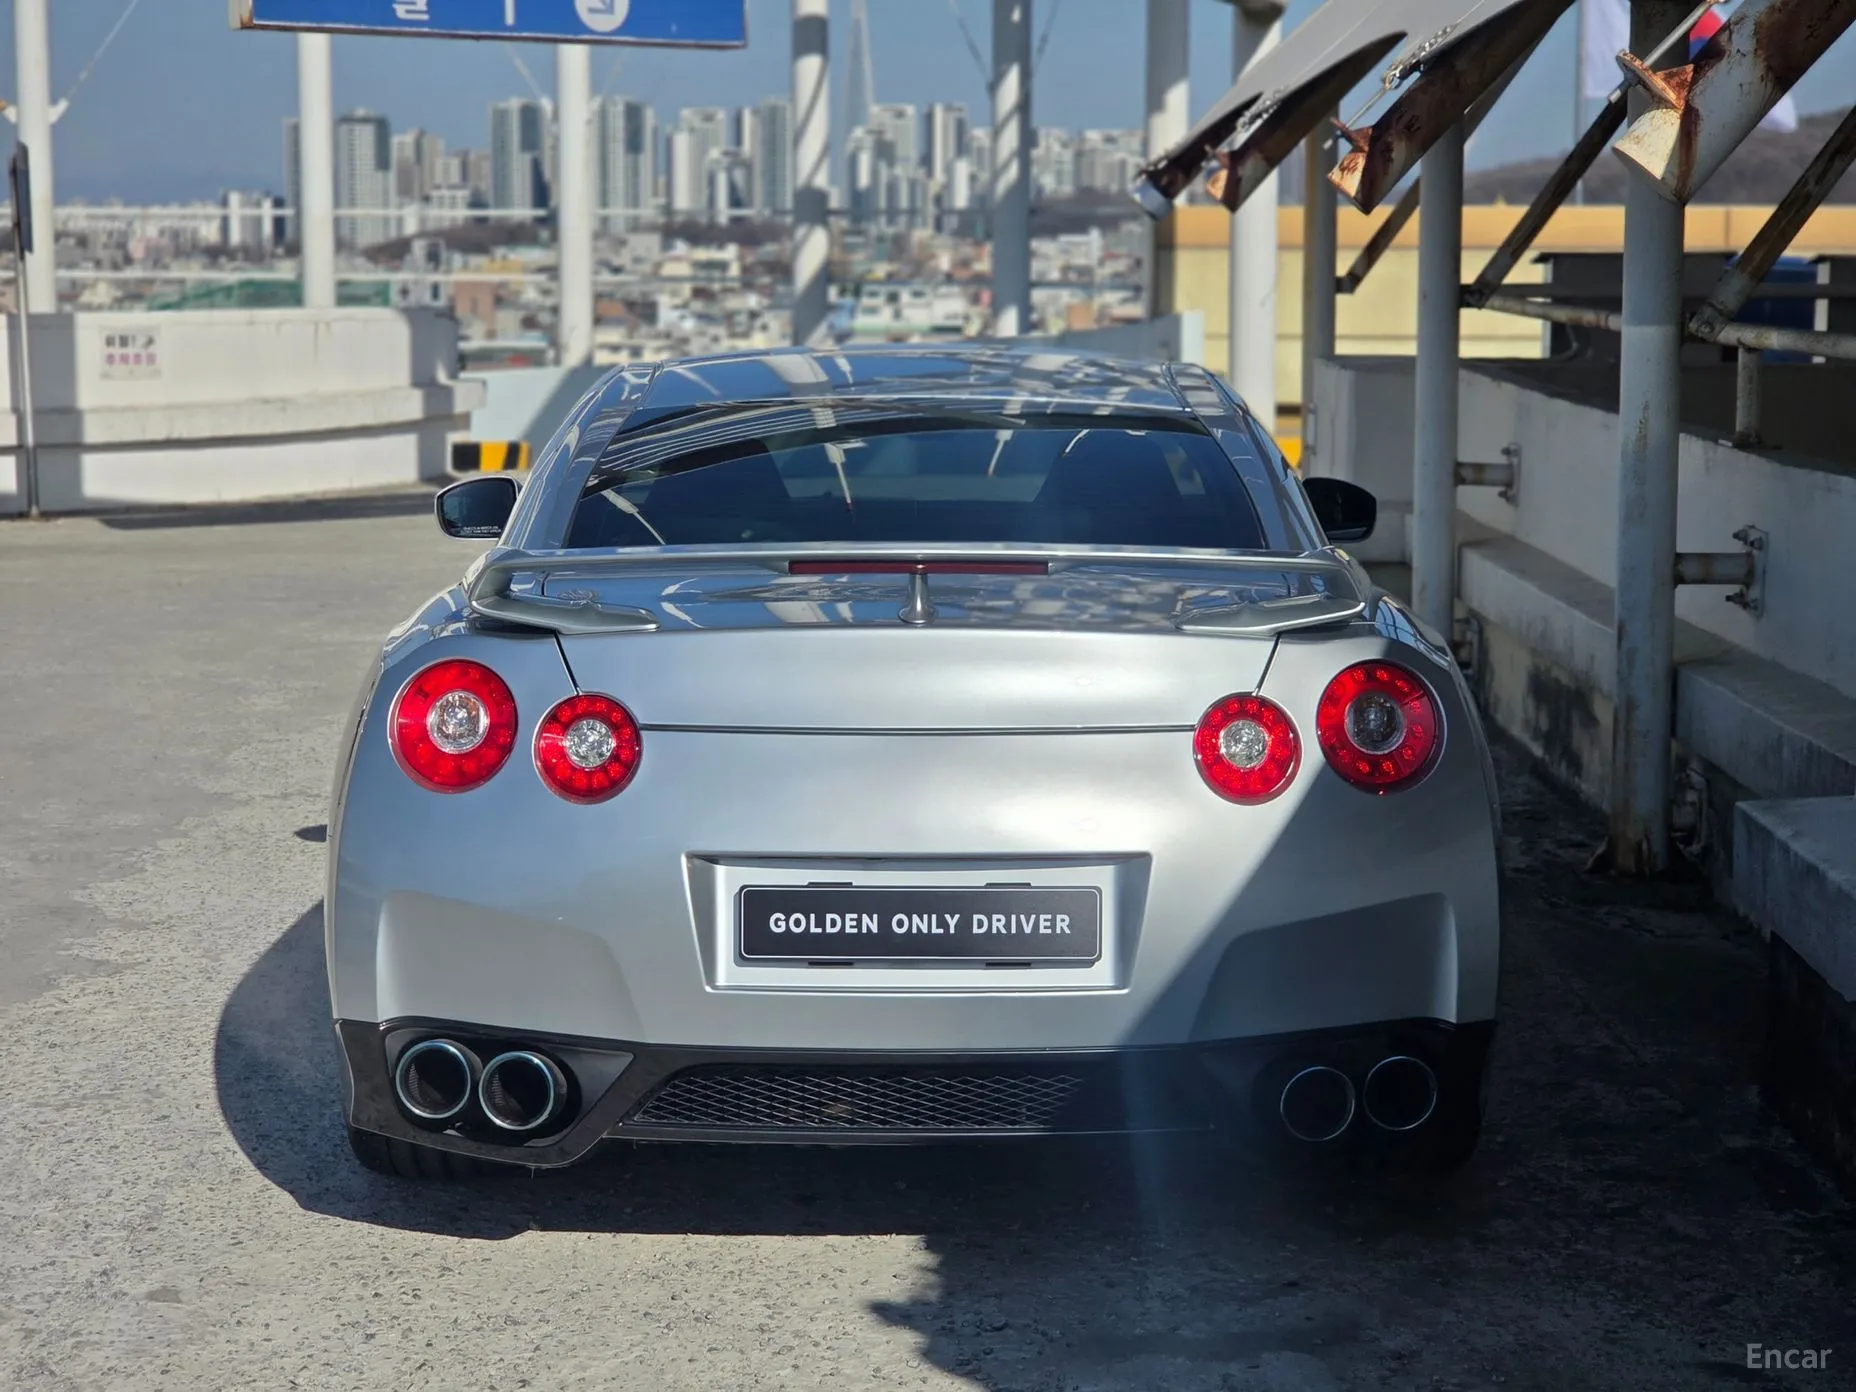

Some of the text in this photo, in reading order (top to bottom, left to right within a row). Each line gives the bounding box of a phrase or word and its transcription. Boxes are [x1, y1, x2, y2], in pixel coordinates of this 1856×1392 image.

[769, 912, 1072, 935] GOLDEN ONLY DRIVER
